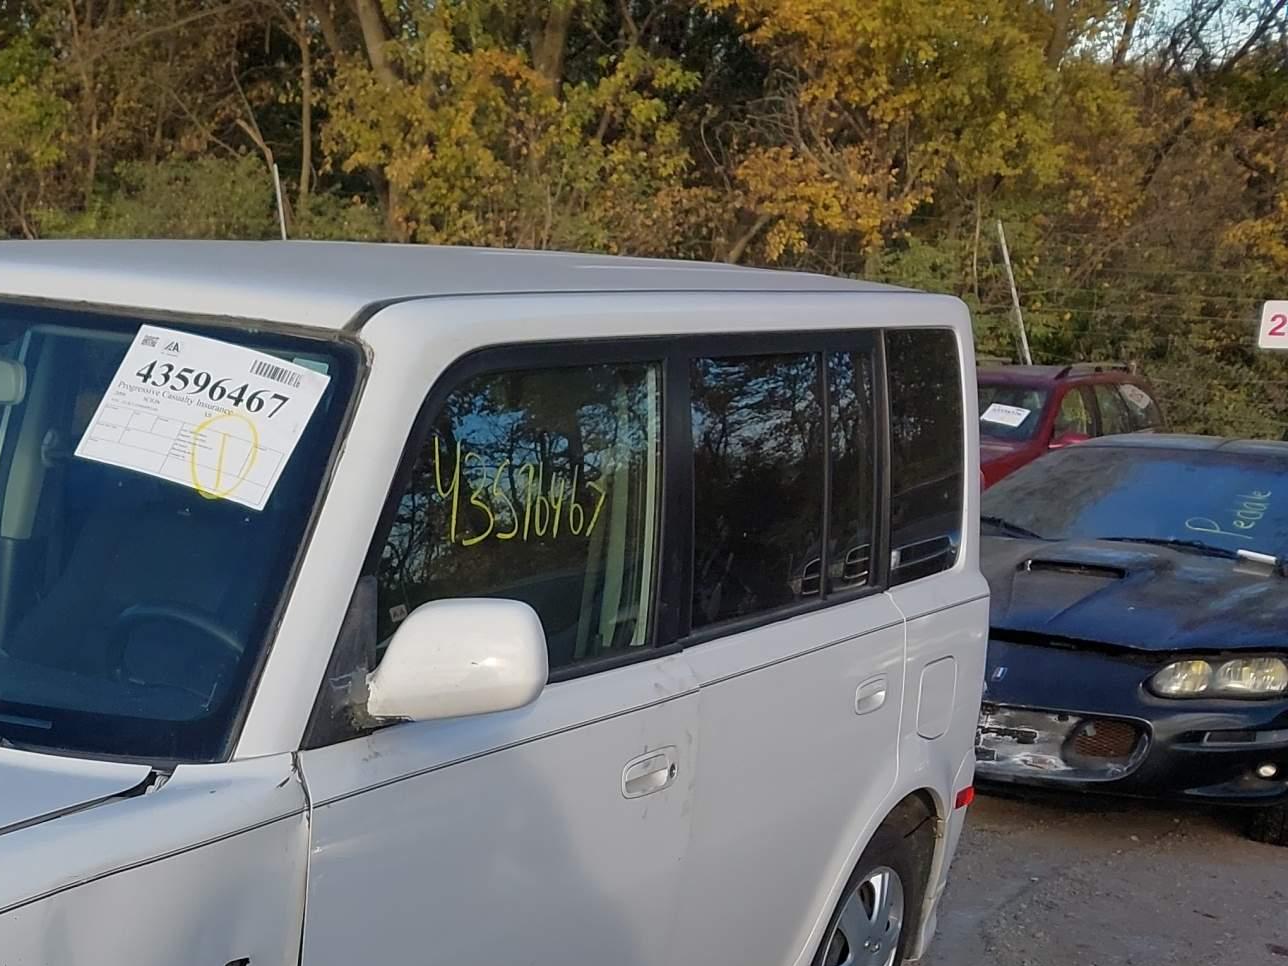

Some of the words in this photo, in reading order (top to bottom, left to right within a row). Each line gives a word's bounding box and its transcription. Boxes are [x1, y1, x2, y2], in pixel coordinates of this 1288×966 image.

[117, 381, 161, 397] Progressive
[161, 390, 194, 406] Casualty
[196, 398, 234, 416] Insurance
[135, 359, 290, 419] 43596467
